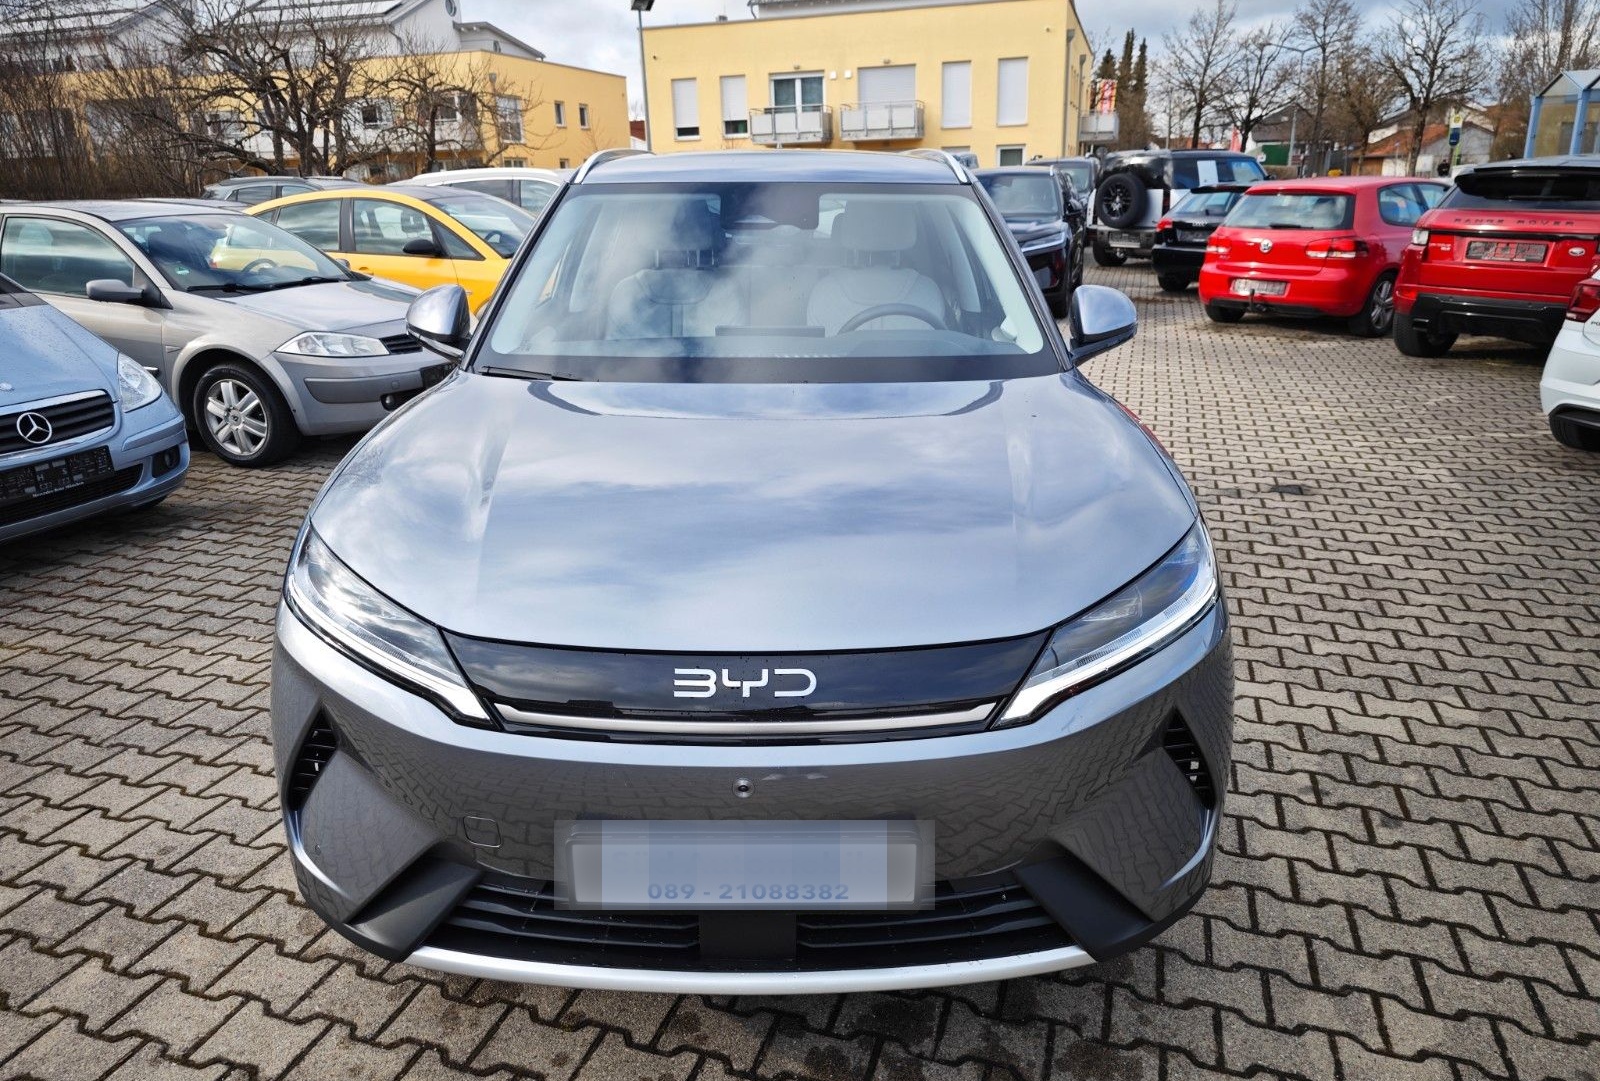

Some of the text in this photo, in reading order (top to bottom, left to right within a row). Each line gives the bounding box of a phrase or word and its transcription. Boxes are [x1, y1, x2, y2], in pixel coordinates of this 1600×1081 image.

[673, 668, 818, 698] BYD
[647, 883, 696, 900] 089
[719, 883, 850, 900] 21088382
